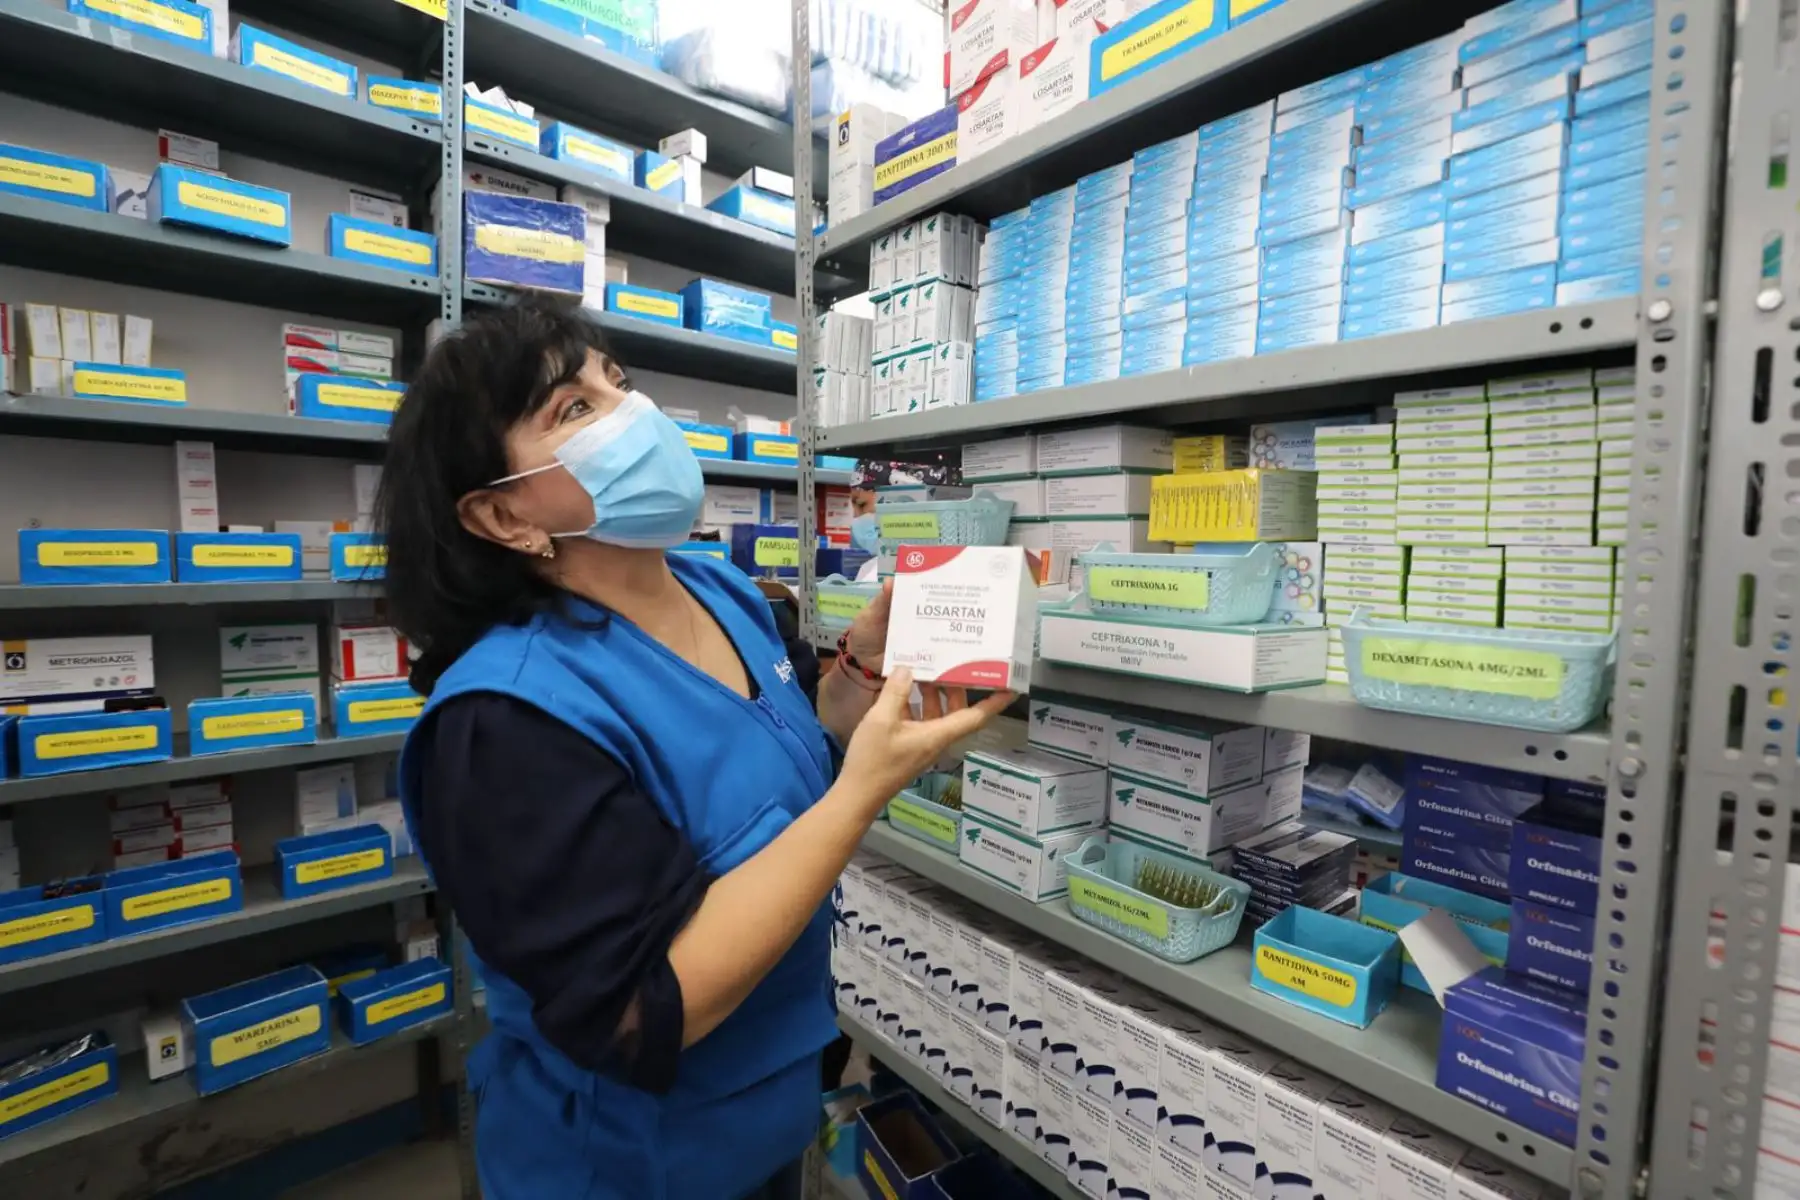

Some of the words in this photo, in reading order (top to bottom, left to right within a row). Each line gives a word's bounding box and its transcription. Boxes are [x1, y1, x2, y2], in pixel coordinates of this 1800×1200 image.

[1032, 72, 1074, 100] LOSARTAN
[969, 110, 1004, 134] LOSARTAN
[876, 151, 925, 183] RANITIDINA
[927, 143, 944, 159] 300
[1110, 579, 1167, 592] CEFTRIAXONA
[1167, 582, 1179, 592] 1G
[915, 603, 987, 620] LOSARTAN
[949, 621, 962, 633] 50
[965, 622, 984, 637] mg
[1091, 631, 1161, 648] CEFTRIAXONA
[1163, 639, 1175, 652] 1g
[49, 654, 135, 666] METRONIDAZOL
[1371, 651, 1475, 673] DEXAMETASONA
[1477, 661, 1549, 679] 4MG/2ML
[1418, 798, 1482, 820] Orfenadrina
[1414, 858, 1478, 882] Orfenadrina
[1083, 887, 1122, 909] METAMIZOL
[1263, 949, 1320, 978] RANITIDINA
[1321, 971, 1351, 989] 50MG
[1290, 975, 1306, 987] AM
[232, 1015, 301, 1044] WARFARINA
[1456, 1051, 1546, 1098] Orfenadrina
